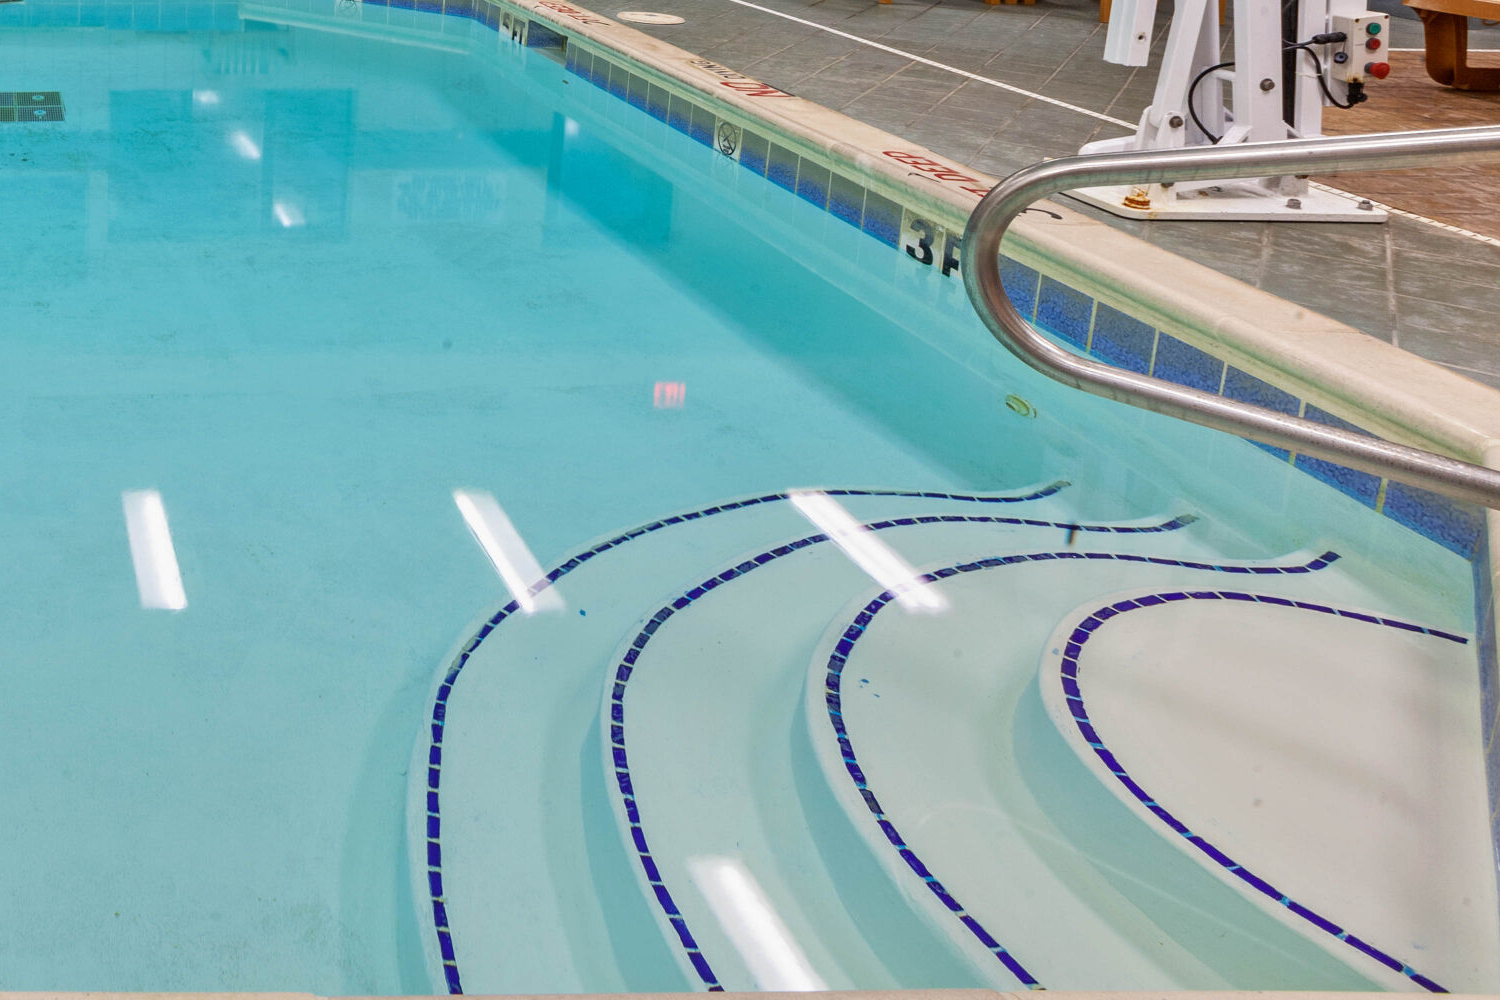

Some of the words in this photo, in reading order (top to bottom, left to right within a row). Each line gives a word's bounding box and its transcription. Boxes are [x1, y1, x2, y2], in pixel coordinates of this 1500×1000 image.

[719, 81, 793, 98] NO
[882, 150, 981, 183] DEEP
[906, 218, 935, 266] 3
